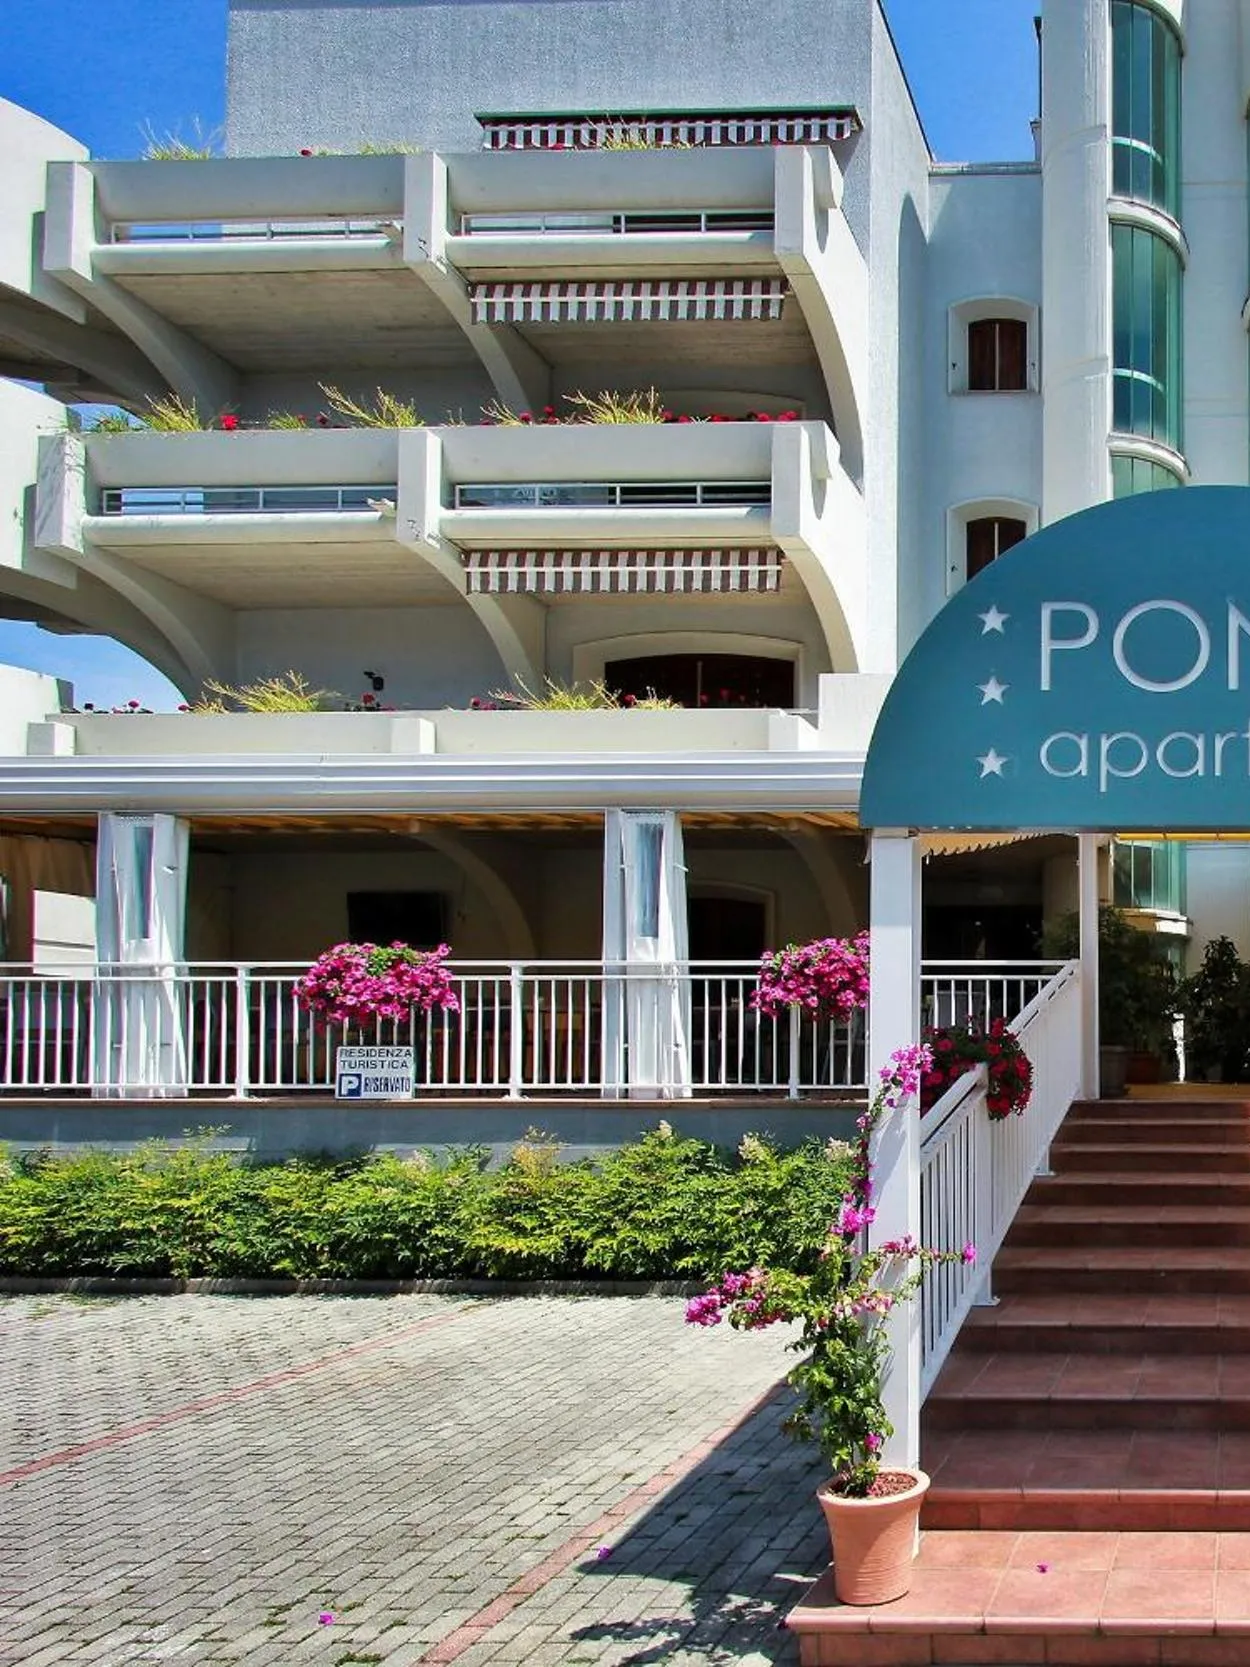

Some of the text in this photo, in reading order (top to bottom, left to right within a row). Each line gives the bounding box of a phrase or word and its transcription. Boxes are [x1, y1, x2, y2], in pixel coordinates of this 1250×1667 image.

[339, 1048, 412, 1058] RESIDENZA
[340, 1060, 409, 1069] TURISTICA
[341, 1074, 411, 1096] P RISERVATO
